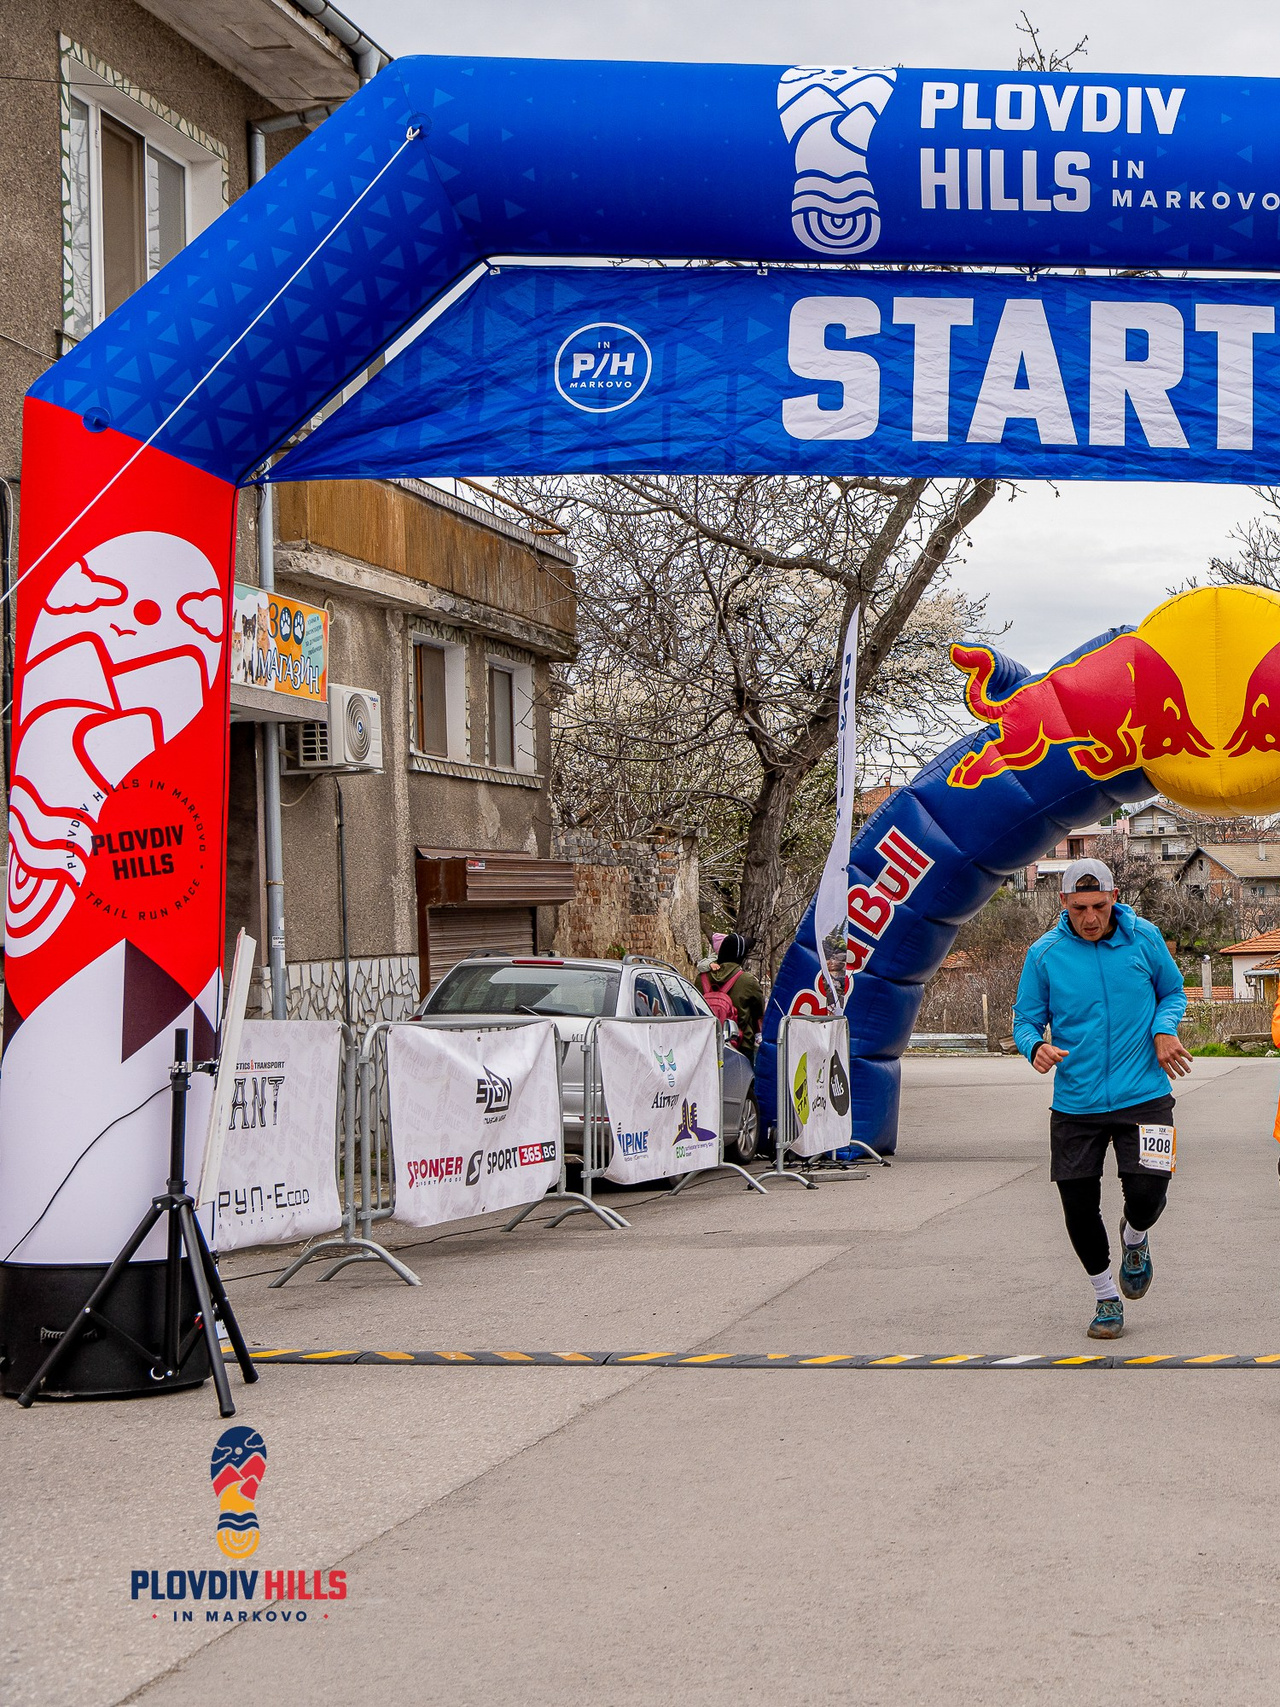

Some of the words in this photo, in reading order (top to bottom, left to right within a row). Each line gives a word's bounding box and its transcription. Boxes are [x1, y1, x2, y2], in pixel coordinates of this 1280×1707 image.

[920, 81, 1186, 135] PLOVDIV
[920, 147, 1091, 213] HILLS
[1112, 160, 1144, 179] IN
[1112, 190, 1280, 211] MARKOVO
[572, 352, 635, 379] P/H
[782, 296, 1275, 451] START
[569, 381, 633, 389] MARKOVO
[257, 647, 320, 694] МАГАЗИН
[66, 803, 90, 870] PLOVDIV
[92, 778, 140, 802] HILLS
[150, 779, 165, 791] IN
[172, 788, 206, 852] MARKOVO
[90, 824, 184, 857] PLOVDIV
[112, 853, 175, 881] HILLS
[85, 891, 128, 920] TRAIL
[138, 908, 169, 921] RUN
[175, 878, 201, 910] RACE
[846, 828, 933, 940] Bull
[254, 1061, 285, 1070] TRANSPORT
[1142, 1137, 1171, 1154] 1208
[407, 1156, 464, 1190] SPONSER
